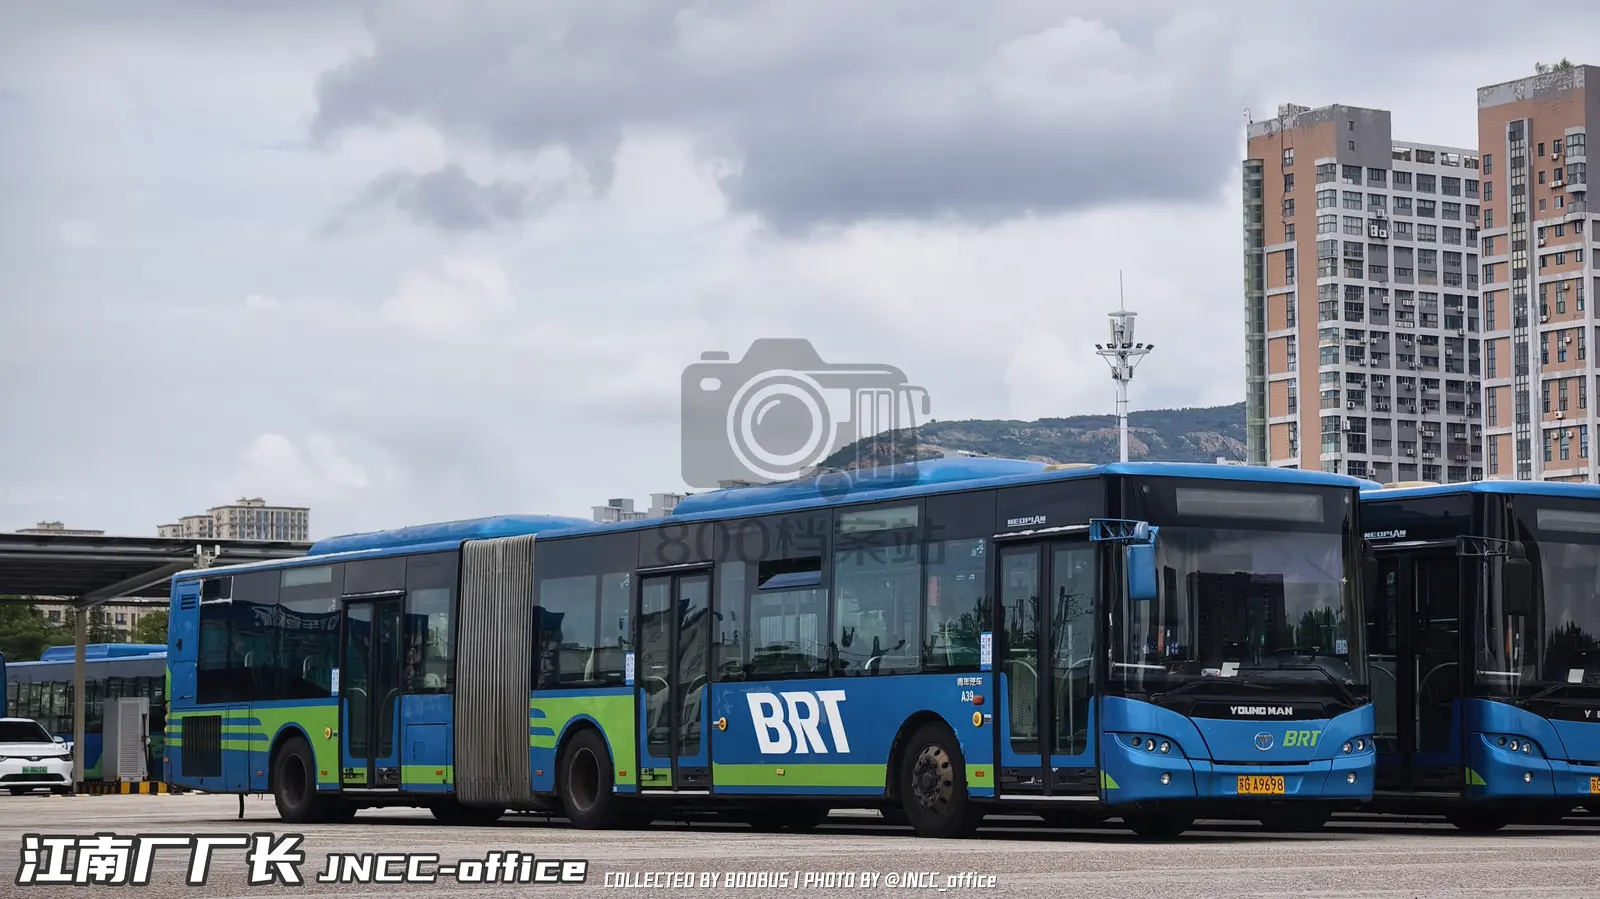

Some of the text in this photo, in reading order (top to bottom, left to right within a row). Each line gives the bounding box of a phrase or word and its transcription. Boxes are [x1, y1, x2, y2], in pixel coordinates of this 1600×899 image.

[1007, 515, 1047, 527] NEOPLAN
[1363, 529, 1407, 540] NEOPLAN
[961, 690, 974, 702] A39
[746, 690, 851, 754] BRT
[1282, 730, 1322, 747] BRT
